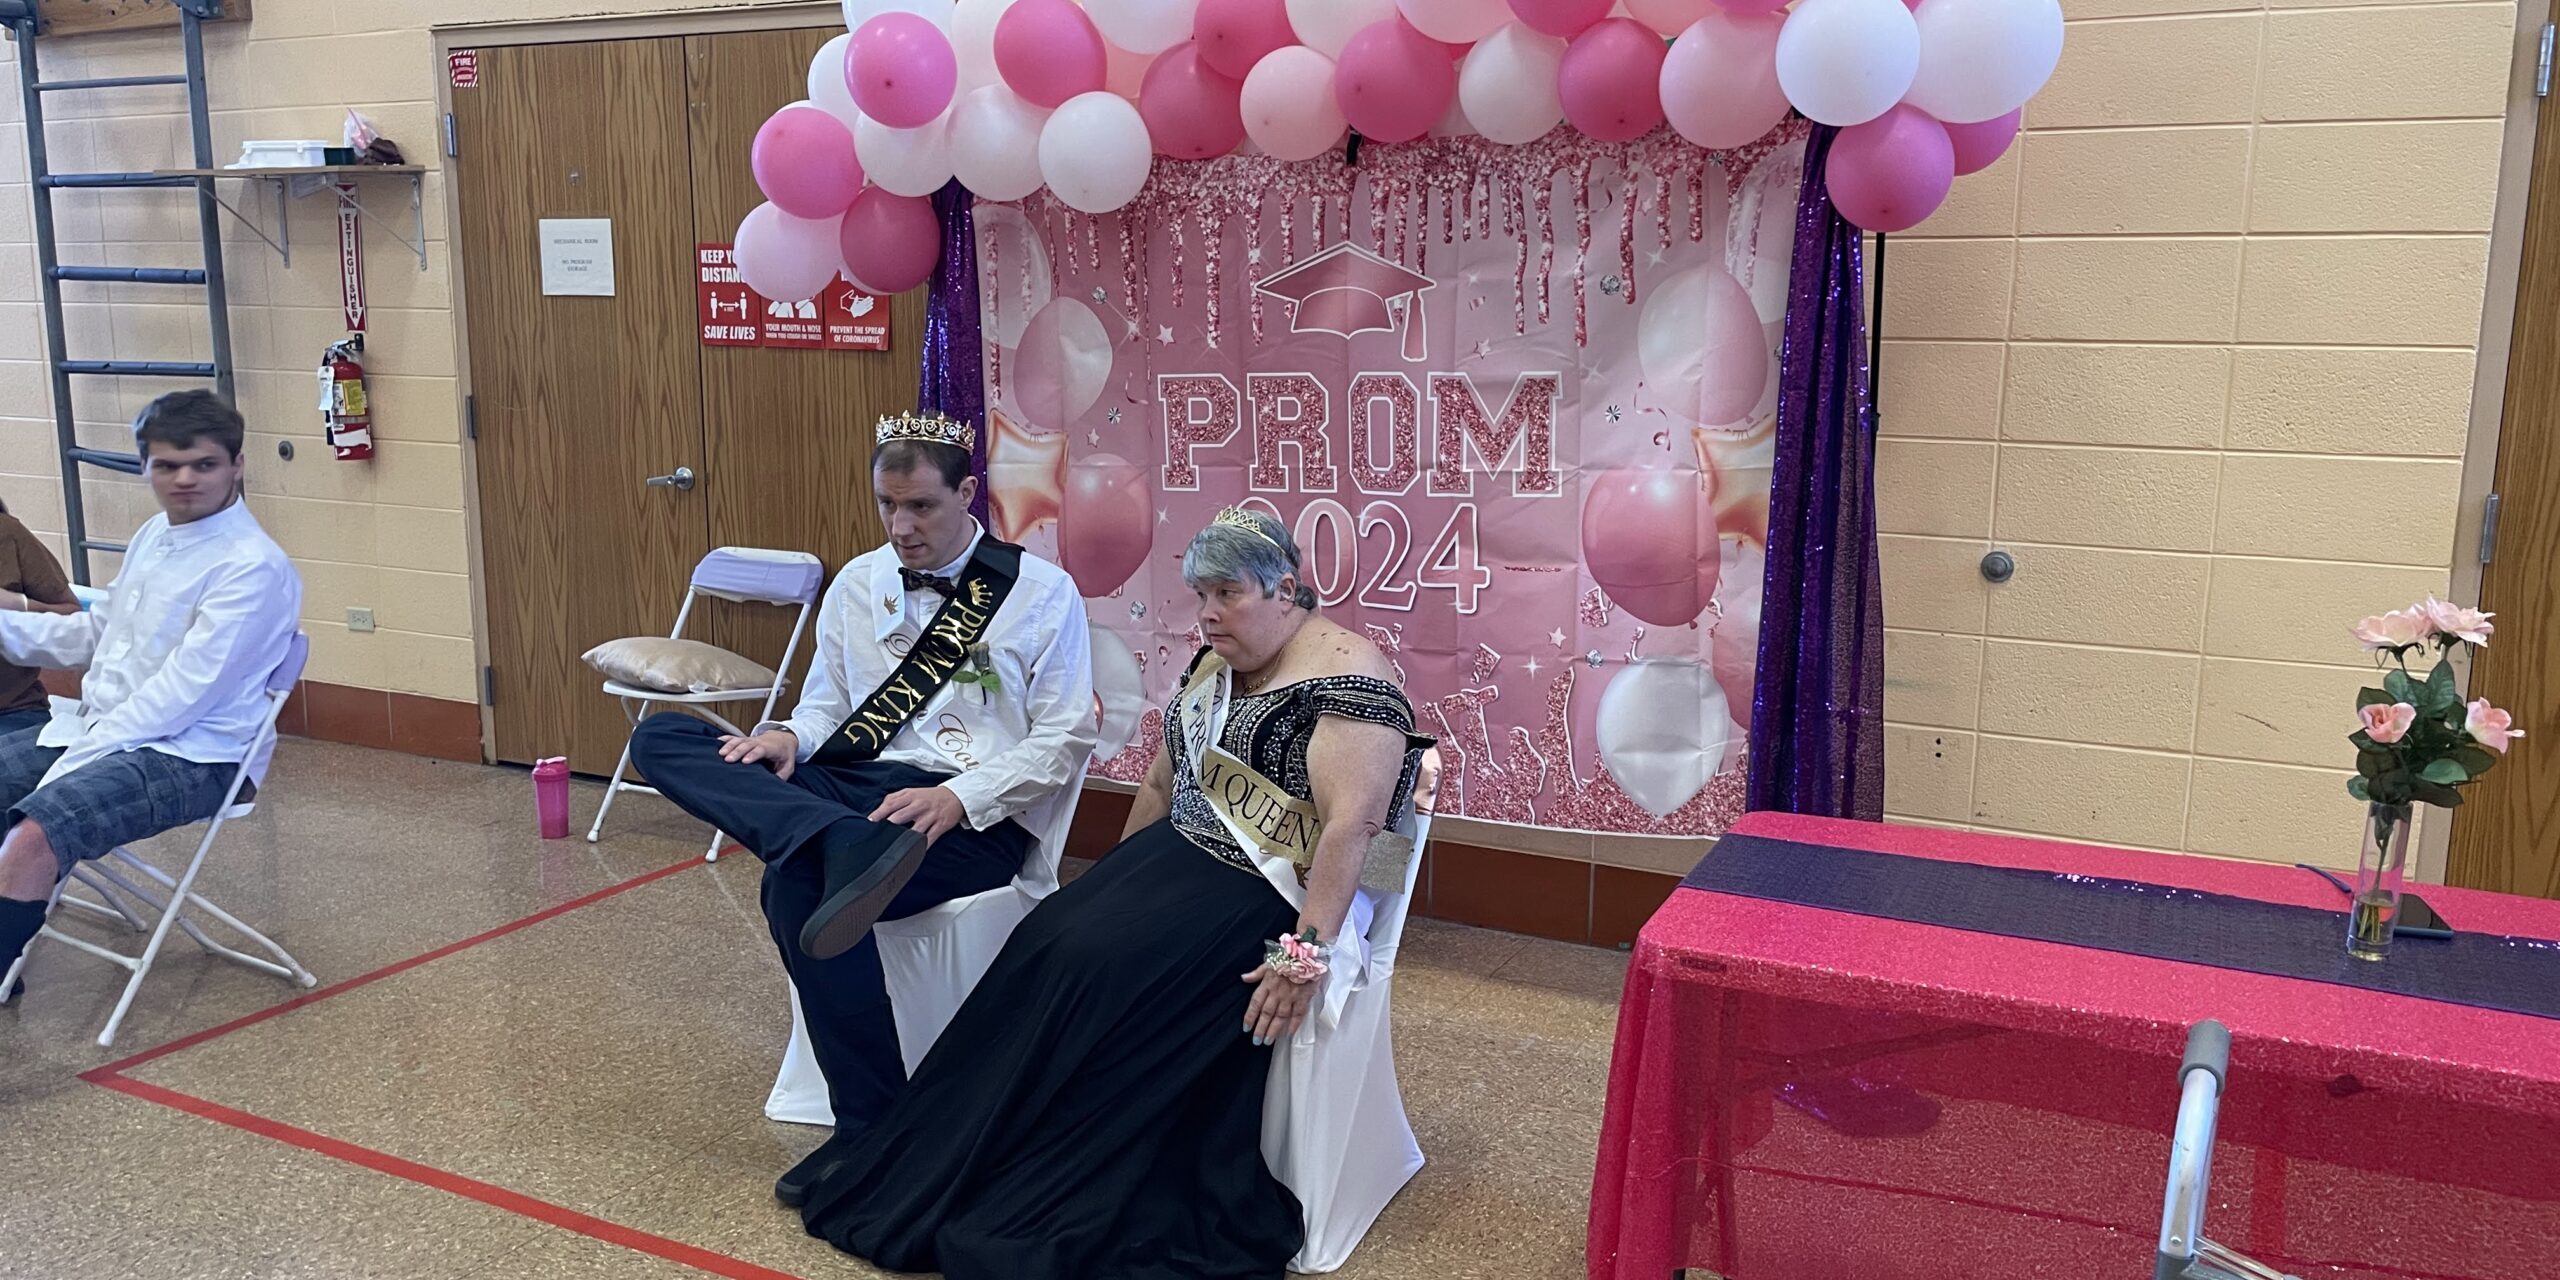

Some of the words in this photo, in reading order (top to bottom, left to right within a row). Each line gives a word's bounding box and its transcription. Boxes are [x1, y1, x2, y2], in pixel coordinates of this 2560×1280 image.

[338, 194, 356, 209] FIRE
[344, 213, 359, 319] EXTINGUISHER
[701, 250, 724, 263] KEEP
[704, 325, 728, 339] SAVE
[729, 326, 756, 340] LIVES
[781, 324, 801, 332] MOUTH
[807, 325, 822, 333] NOSE
[829, 325, 853, 334] PREVENT
[854, 326, 864, 334] THE
[864, 326, 886, 335] SPREAD
[833, 334, 841, 343] OF
[842, 335, 880, 344] CORONAVIRUS
[1157, 371, 1563, 498] PROM
[1236, 496, 1491, 615] 024
[911, 598, 987, 685] PROM
[844, 673, 926, 751] KING
[1225, 772, 1320, 853] QUEEN
